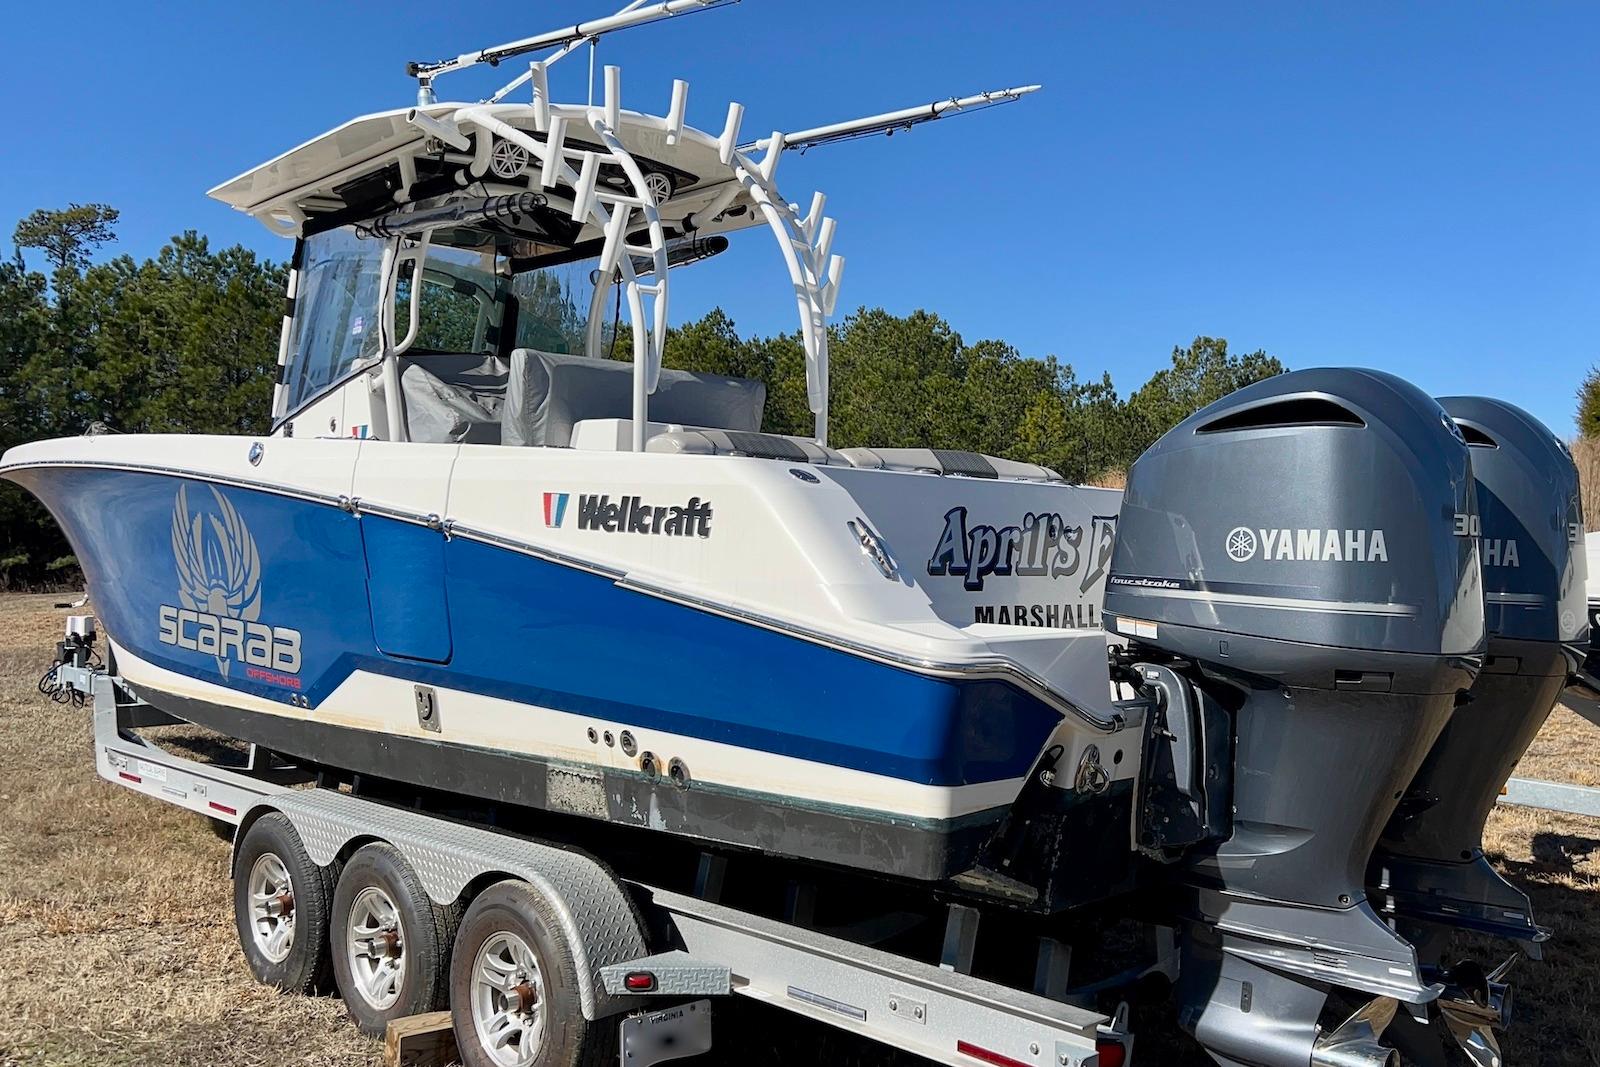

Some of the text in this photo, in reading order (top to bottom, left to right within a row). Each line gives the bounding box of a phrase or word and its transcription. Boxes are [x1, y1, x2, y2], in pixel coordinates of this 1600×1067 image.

[577, 493, 714, 538] Wellcraft
[928, 506, 1083, 591] April's
[1259, 528, 1389, 562] YAMAHA
[1110, 576, 1180, 589] fourstroke
[974, 603, 1103, 631] MARSHALL
[246, 668, 301, 689] OFFSHORE
[650, 1010, 684, 1025] VIRGINIA
